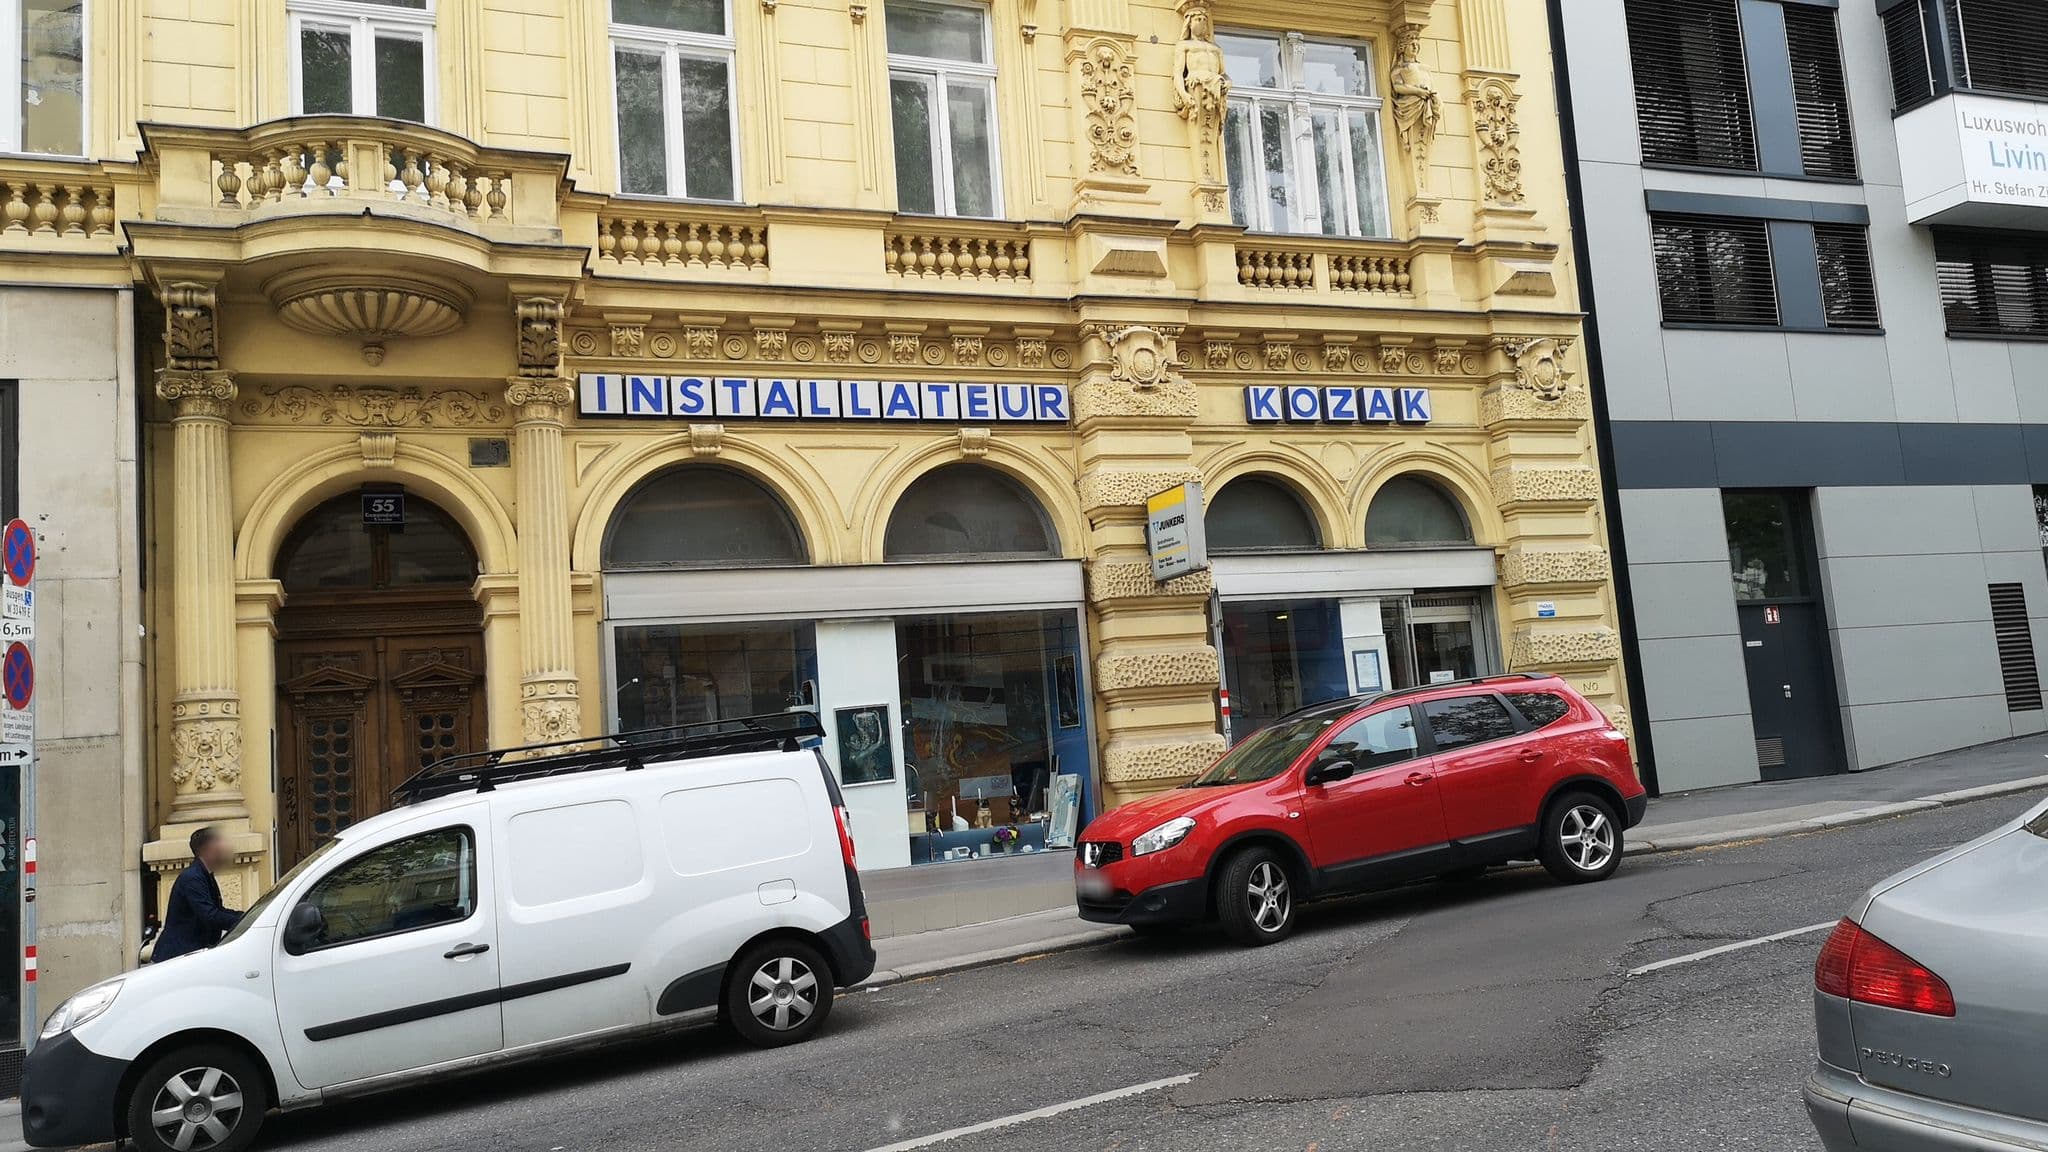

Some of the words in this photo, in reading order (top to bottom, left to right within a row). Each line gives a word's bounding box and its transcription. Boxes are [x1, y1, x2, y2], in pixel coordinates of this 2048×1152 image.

[1962, 111, 2047, 136] Luxuswoh
[1989, 141, 2047, 171] Livin
[1972, 180, 1991, 193] Hr.
[1994, 182, 2035, 198] Stefan
[597, 376, 1066, 418] INSTALLATEUR
[1253, 387, 1428, 419] KOZAK
[372, 499, 395, 512] 55
[1159, 514, 1184, 531] JUNKERS
[3, 622, 31, 637] 6,5m
[1583, 682, 1599, 691] NO
[1862, 1047, 1952, 1078] PEUGEO
